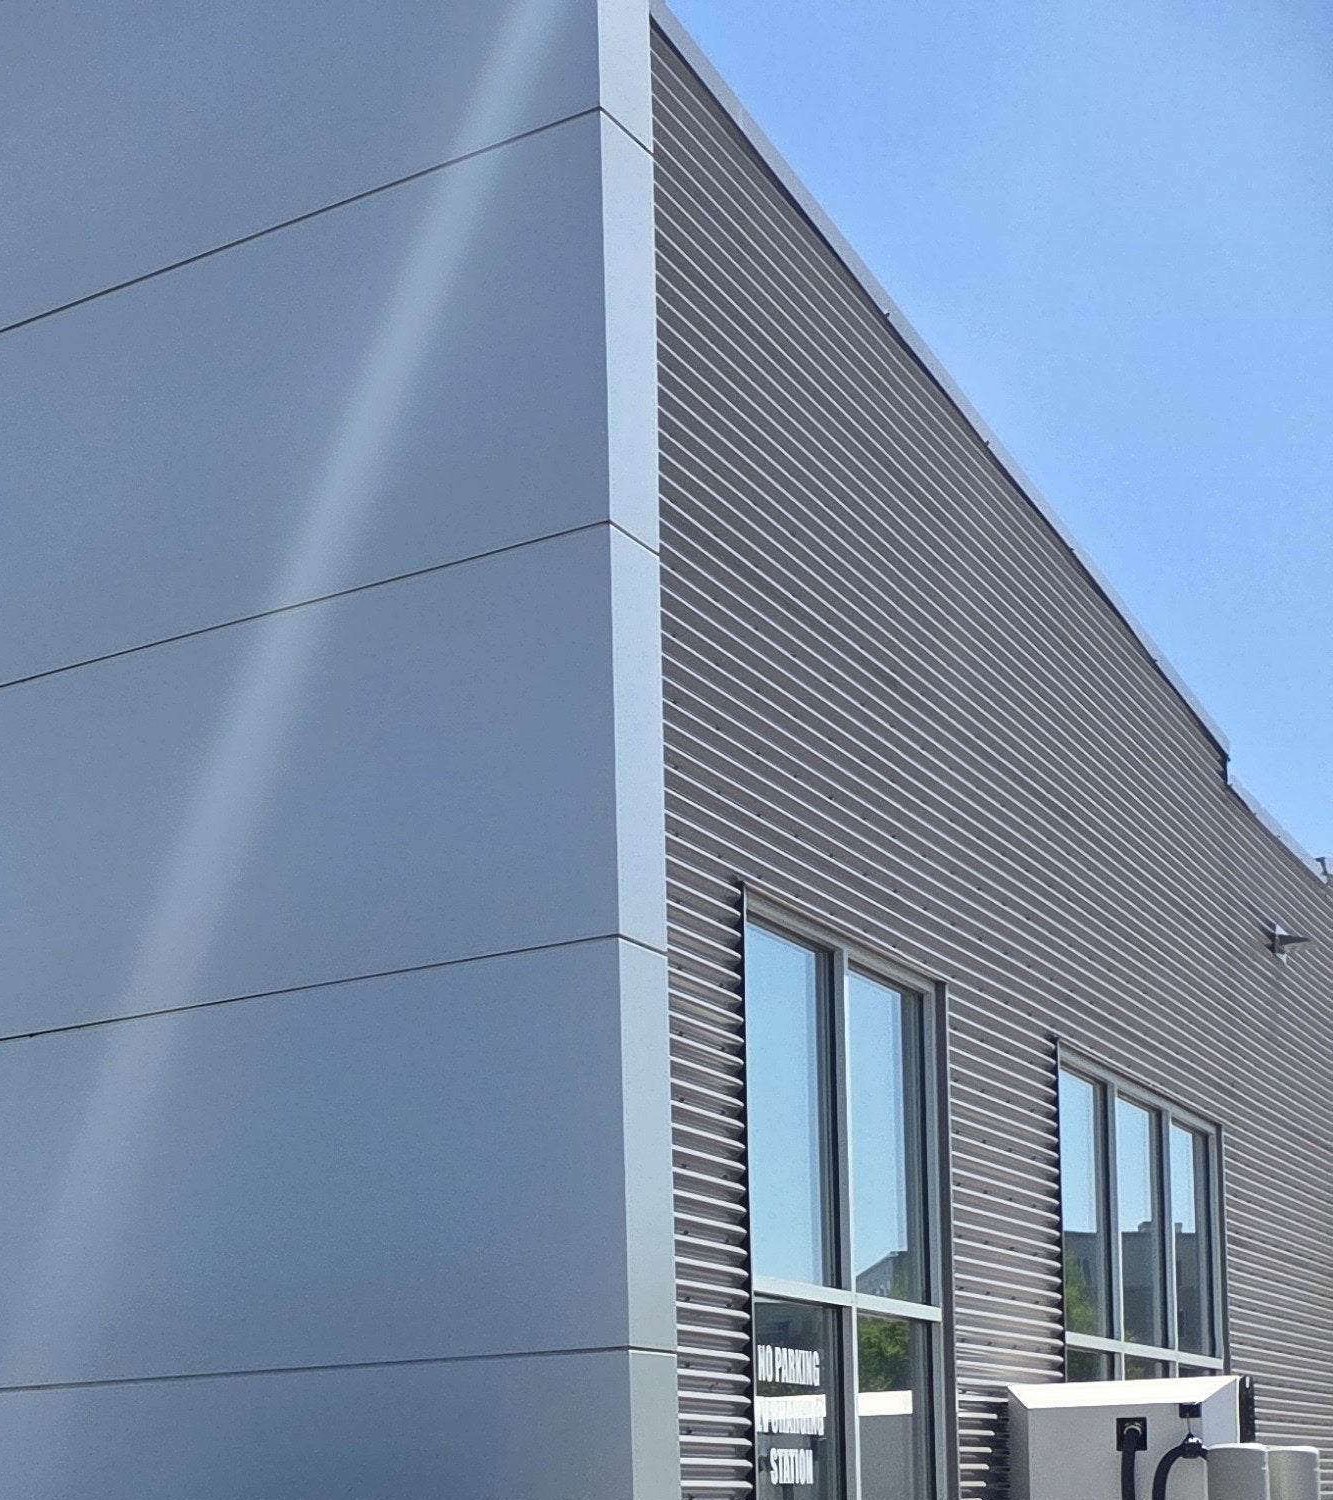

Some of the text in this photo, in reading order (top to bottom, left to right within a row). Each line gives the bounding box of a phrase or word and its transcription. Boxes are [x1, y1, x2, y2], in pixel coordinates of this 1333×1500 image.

[757, 1345, 821, 1387] NO PARKING
[770, 1447, 814, 1485] STATION
